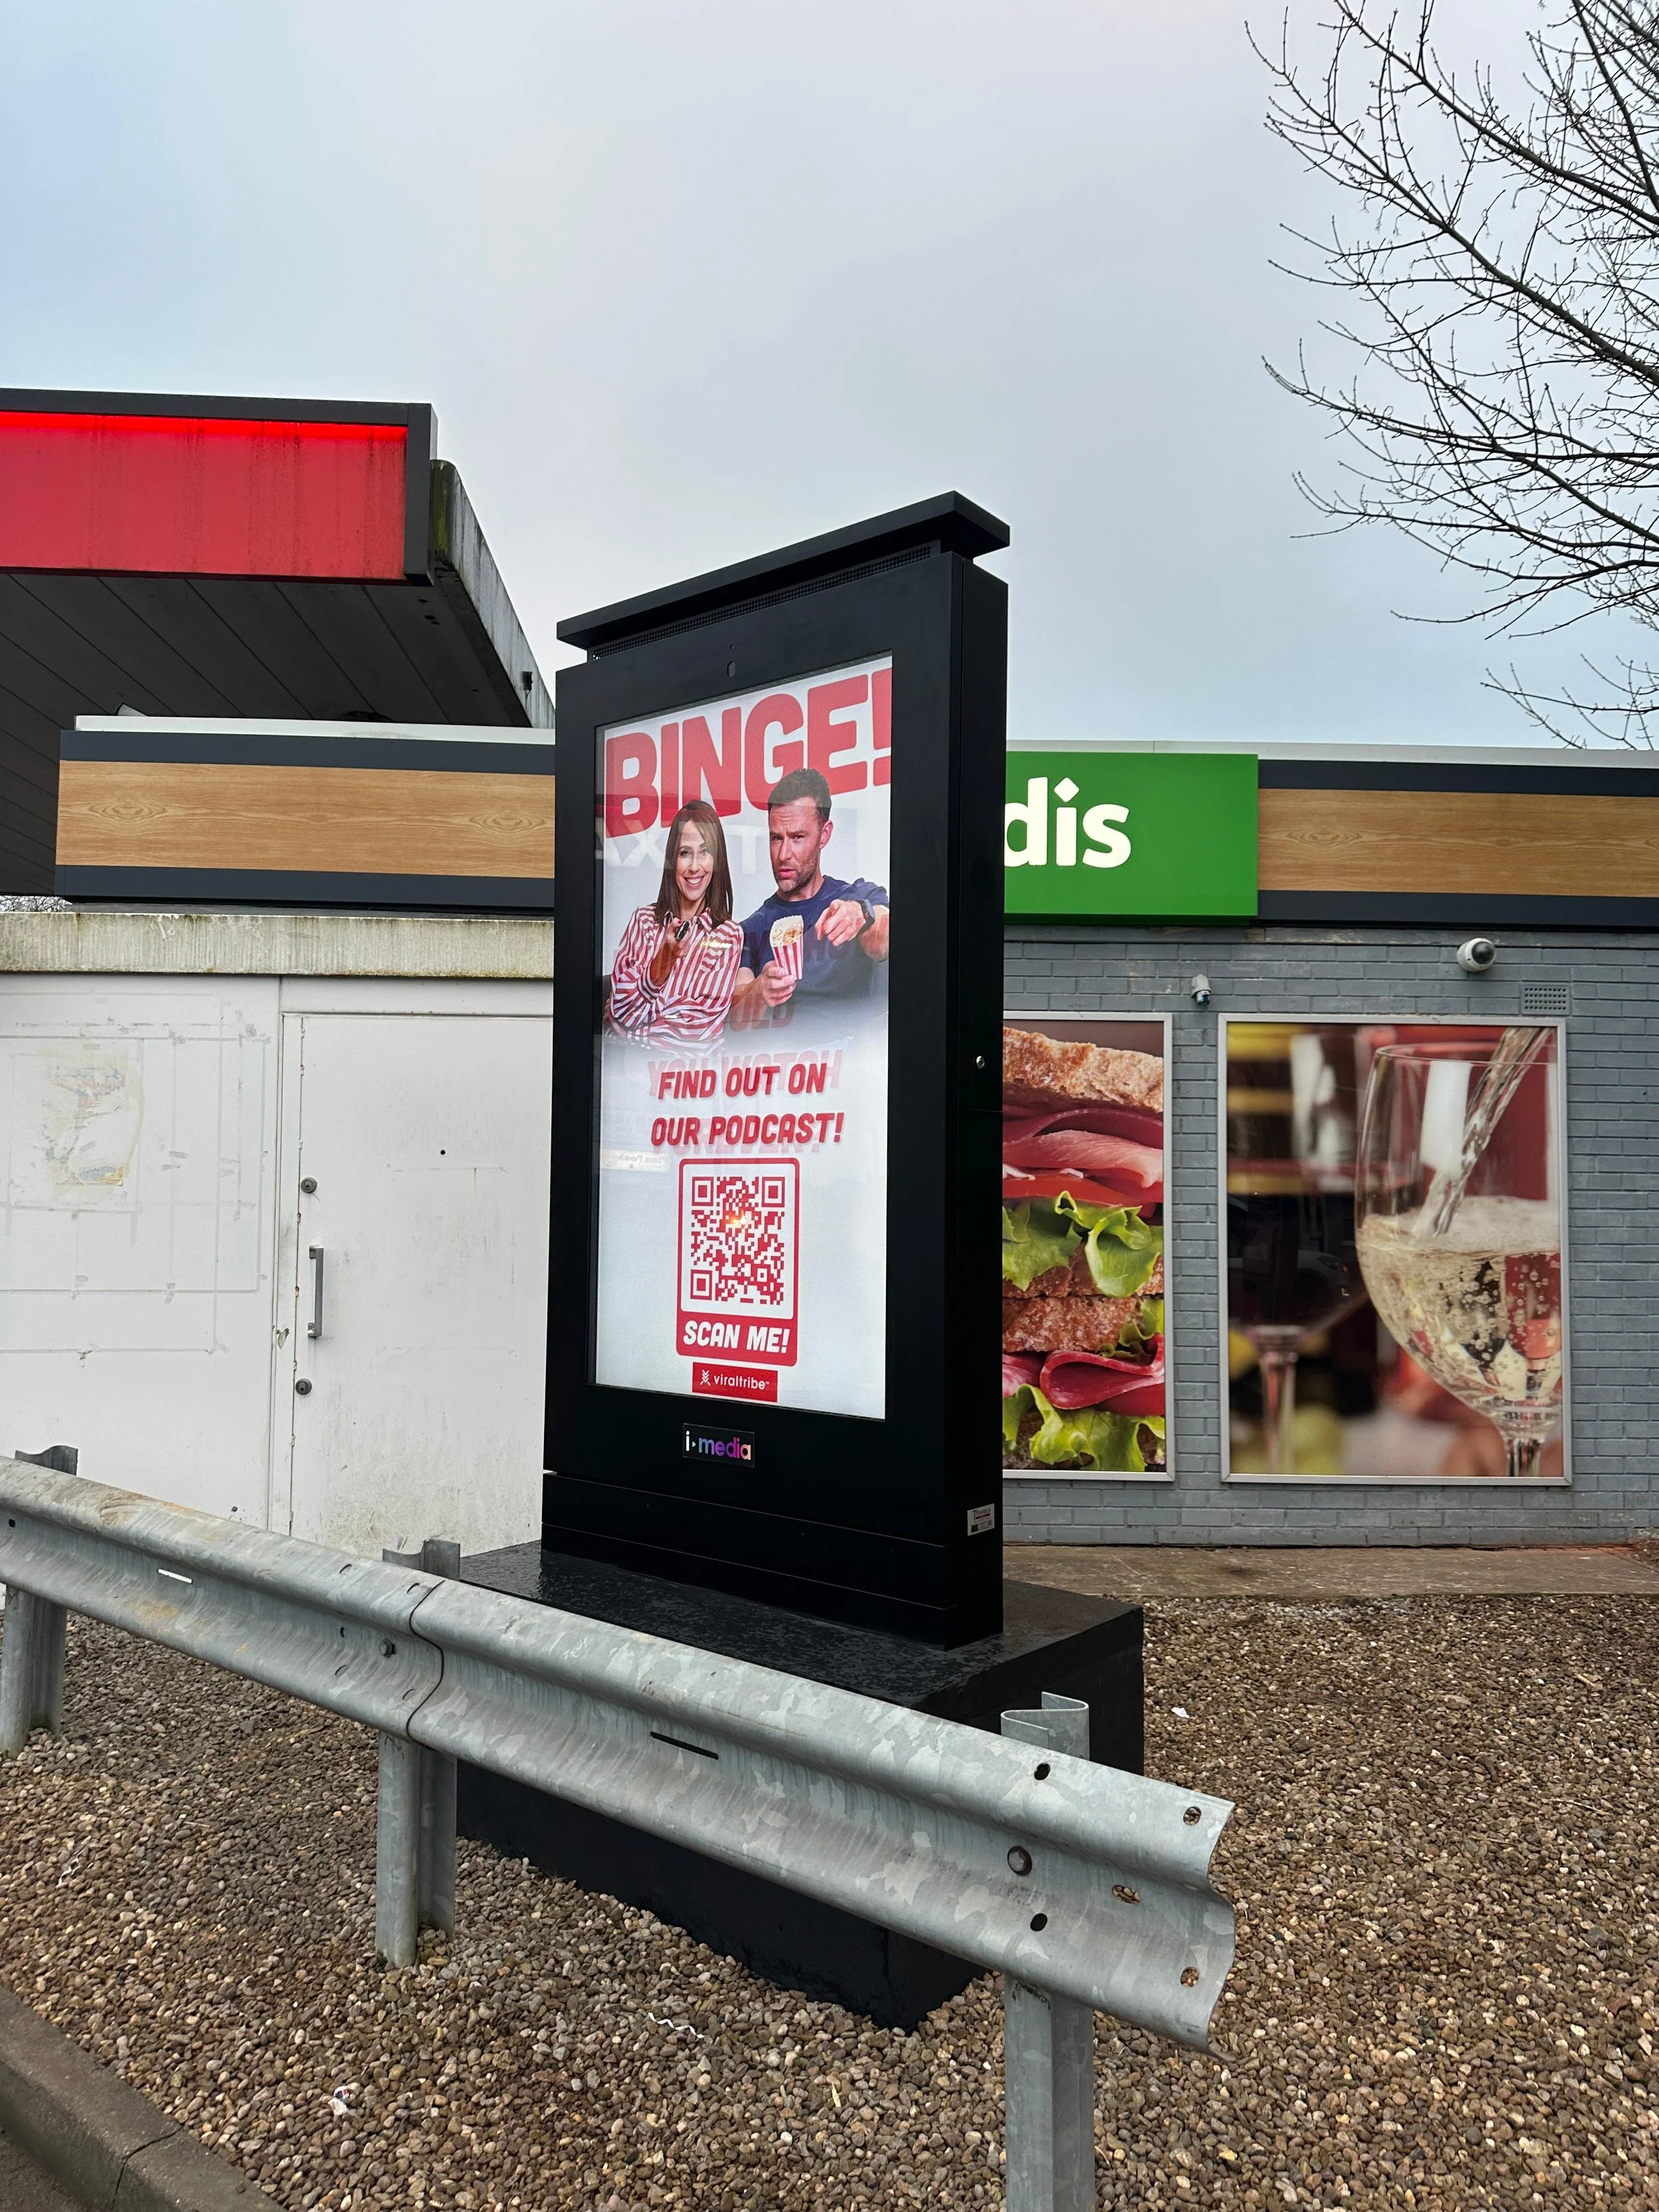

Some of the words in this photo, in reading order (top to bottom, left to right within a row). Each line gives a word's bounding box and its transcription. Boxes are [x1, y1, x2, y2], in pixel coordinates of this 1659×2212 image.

[606, 668, 892, 838] BINGE!
[1004, 776, 1131, 868] dis
[658, 1069, 717, 1100] FIND
[725, 1065, 780, 1098] OUT
[788, 1063, 828, 1095] ON
[650, 1116, 701, 1147] OUR
[708, 1112, 845, 1145] PODCAST!
[683, 1320, 741, 1349] SCAN
[746, 1325, 791, 1354] ME!
